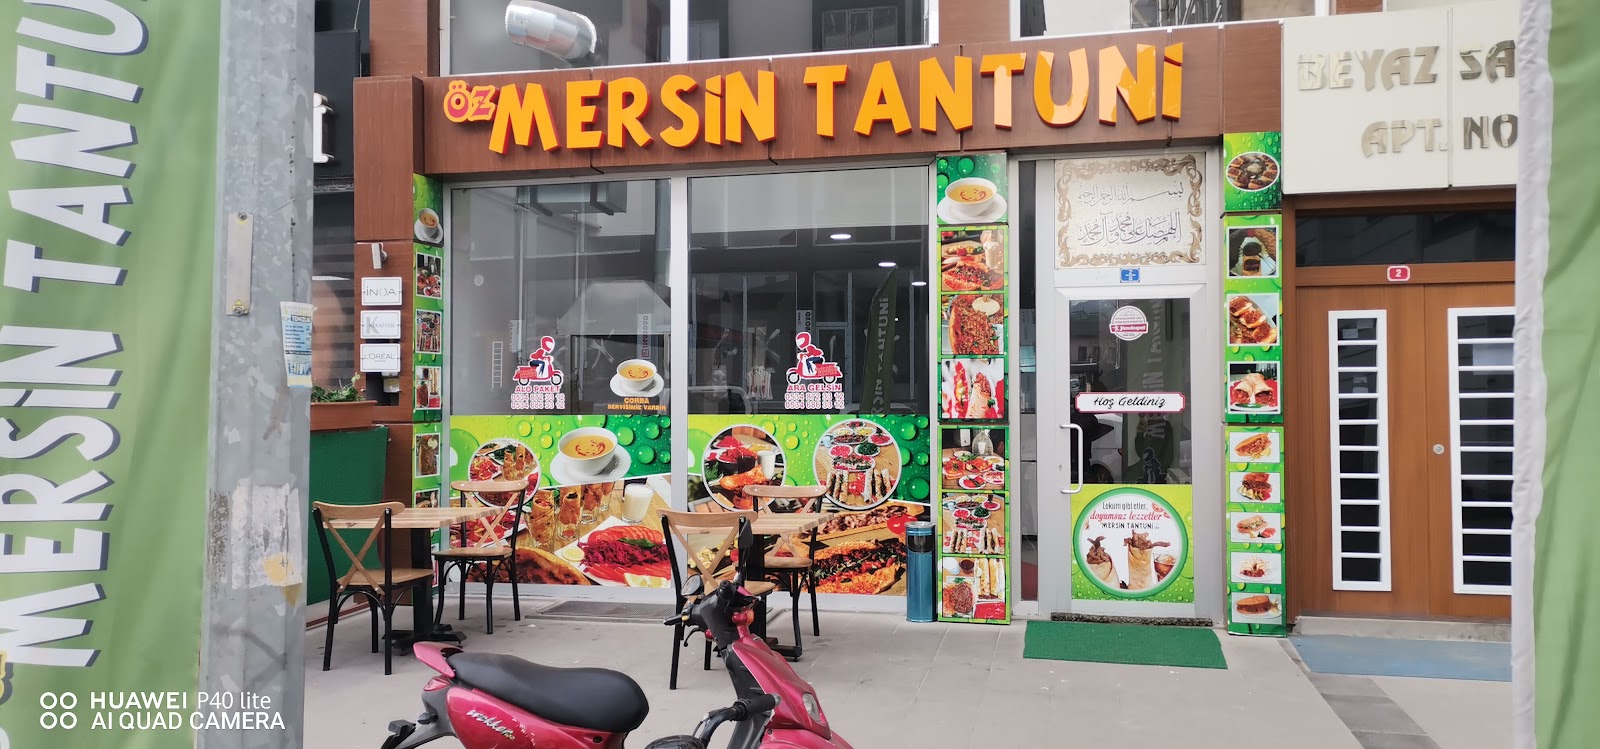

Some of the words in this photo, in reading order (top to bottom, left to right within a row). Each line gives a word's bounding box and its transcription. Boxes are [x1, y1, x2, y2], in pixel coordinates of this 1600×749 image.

[1298, 46, 1440, 92] BEYAZ
[444, 80, 498, 123] ÖZ
[1361, 118, 1448, 158] APT.
[1463, 114, 1519, 150] NO
[1395, 268, 1403, 279] 2
[515, 385, 532, 393] ALO
[533, 385, 561, 393] PAKET
[787, 384, 807, 392] ARA
[1118, 397, 1166, 409] Geldiniz
[1121, 502, 1133, 511] gibi
[1129, 511, 1162, 521] lezzetler
